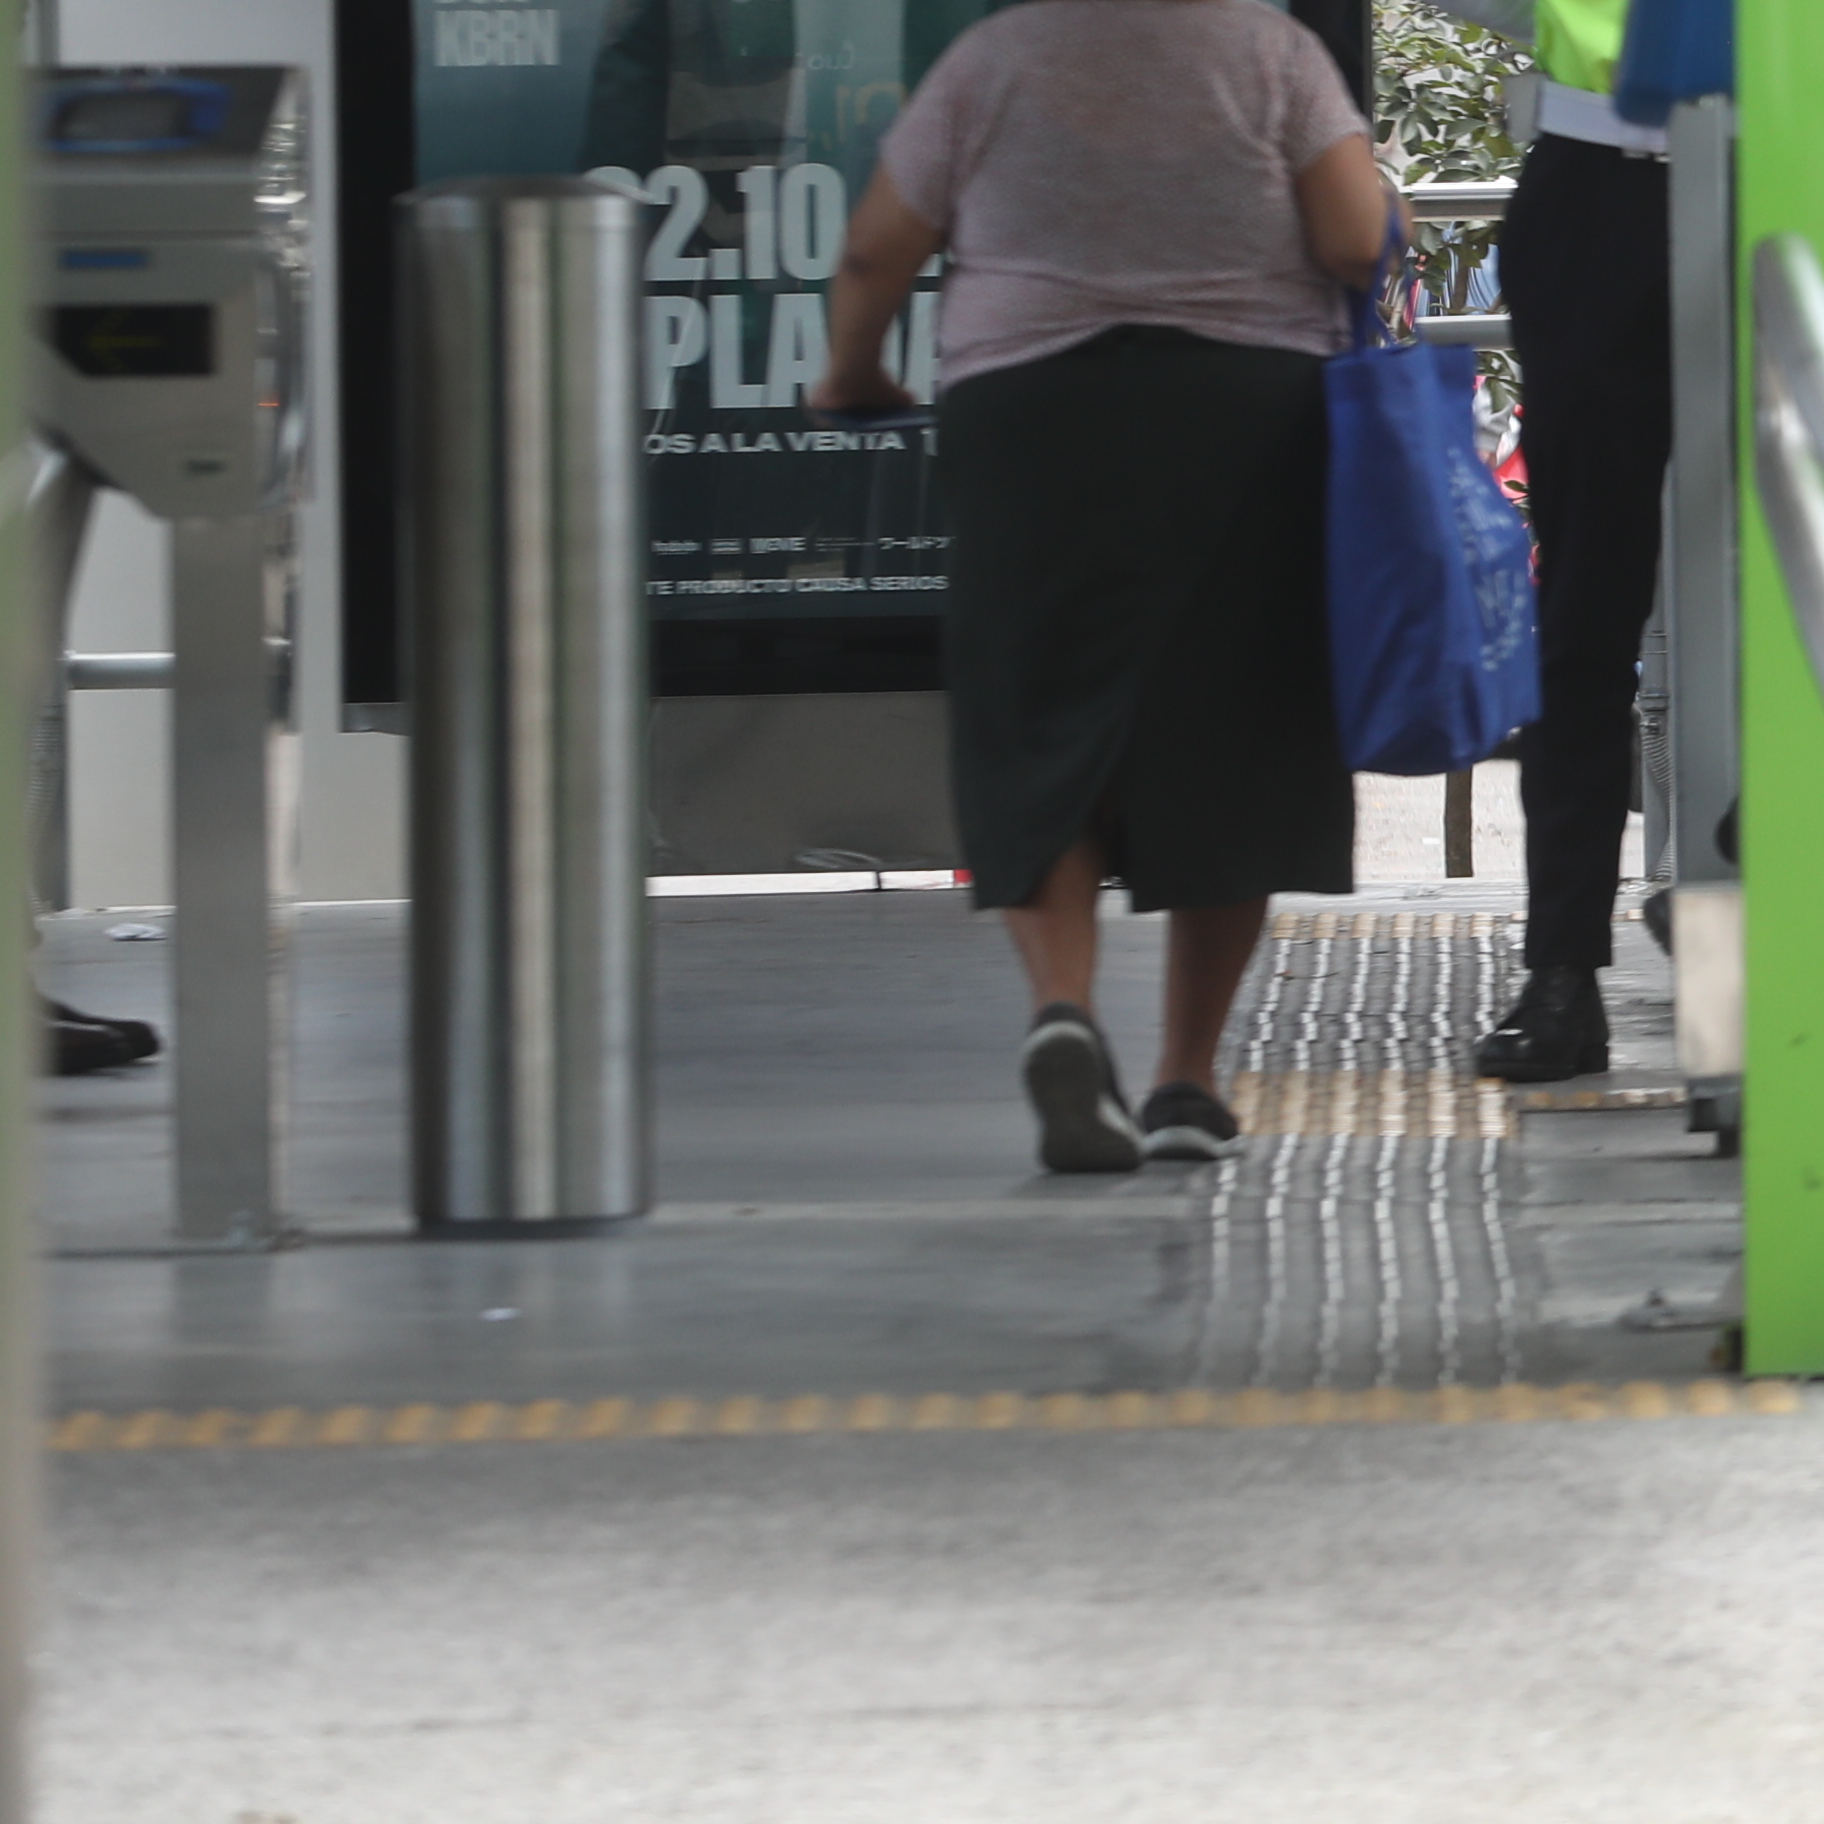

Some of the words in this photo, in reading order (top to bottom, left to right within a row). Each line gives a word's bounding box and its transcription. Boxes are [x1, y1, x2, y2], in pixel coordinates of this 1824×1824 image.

[434, 9, 562, 67] KBRN
[731, 432, 783, 453] LA
[783, 431, 908, 452] VENTA
